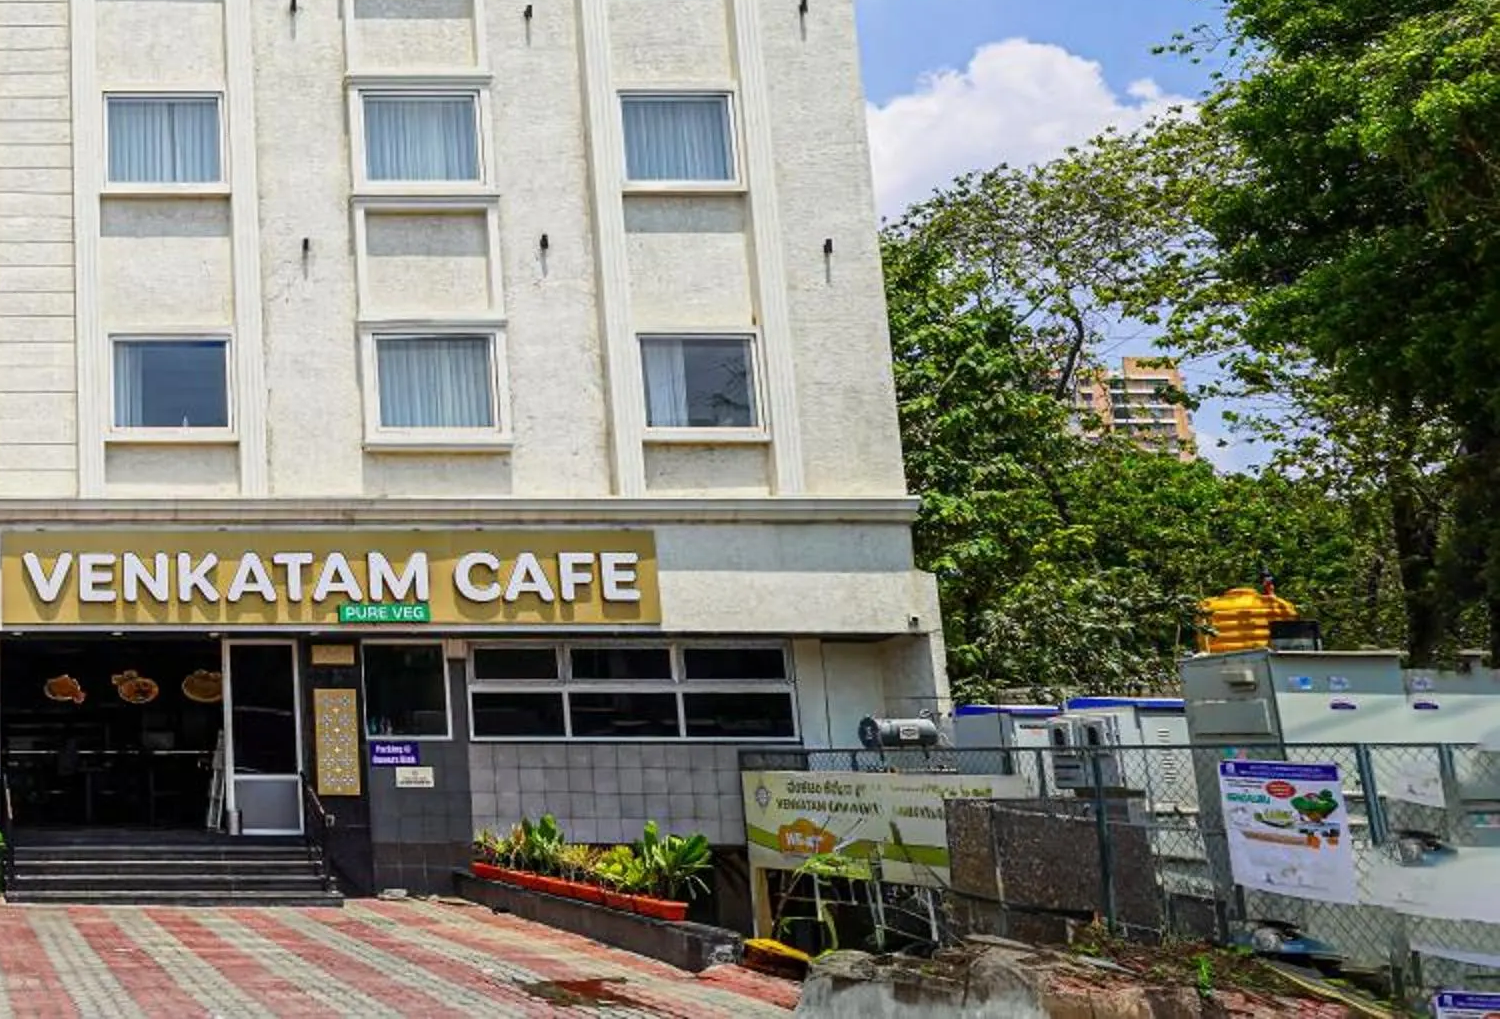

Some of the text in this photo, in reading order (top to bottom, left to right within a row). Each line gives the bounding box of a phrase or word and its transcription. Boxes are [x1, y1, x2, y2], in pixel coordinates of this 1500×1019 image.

[22, 552, 641, 602] VENKATAM CAFE
[346, 606, 424, 621] PURE VEG
